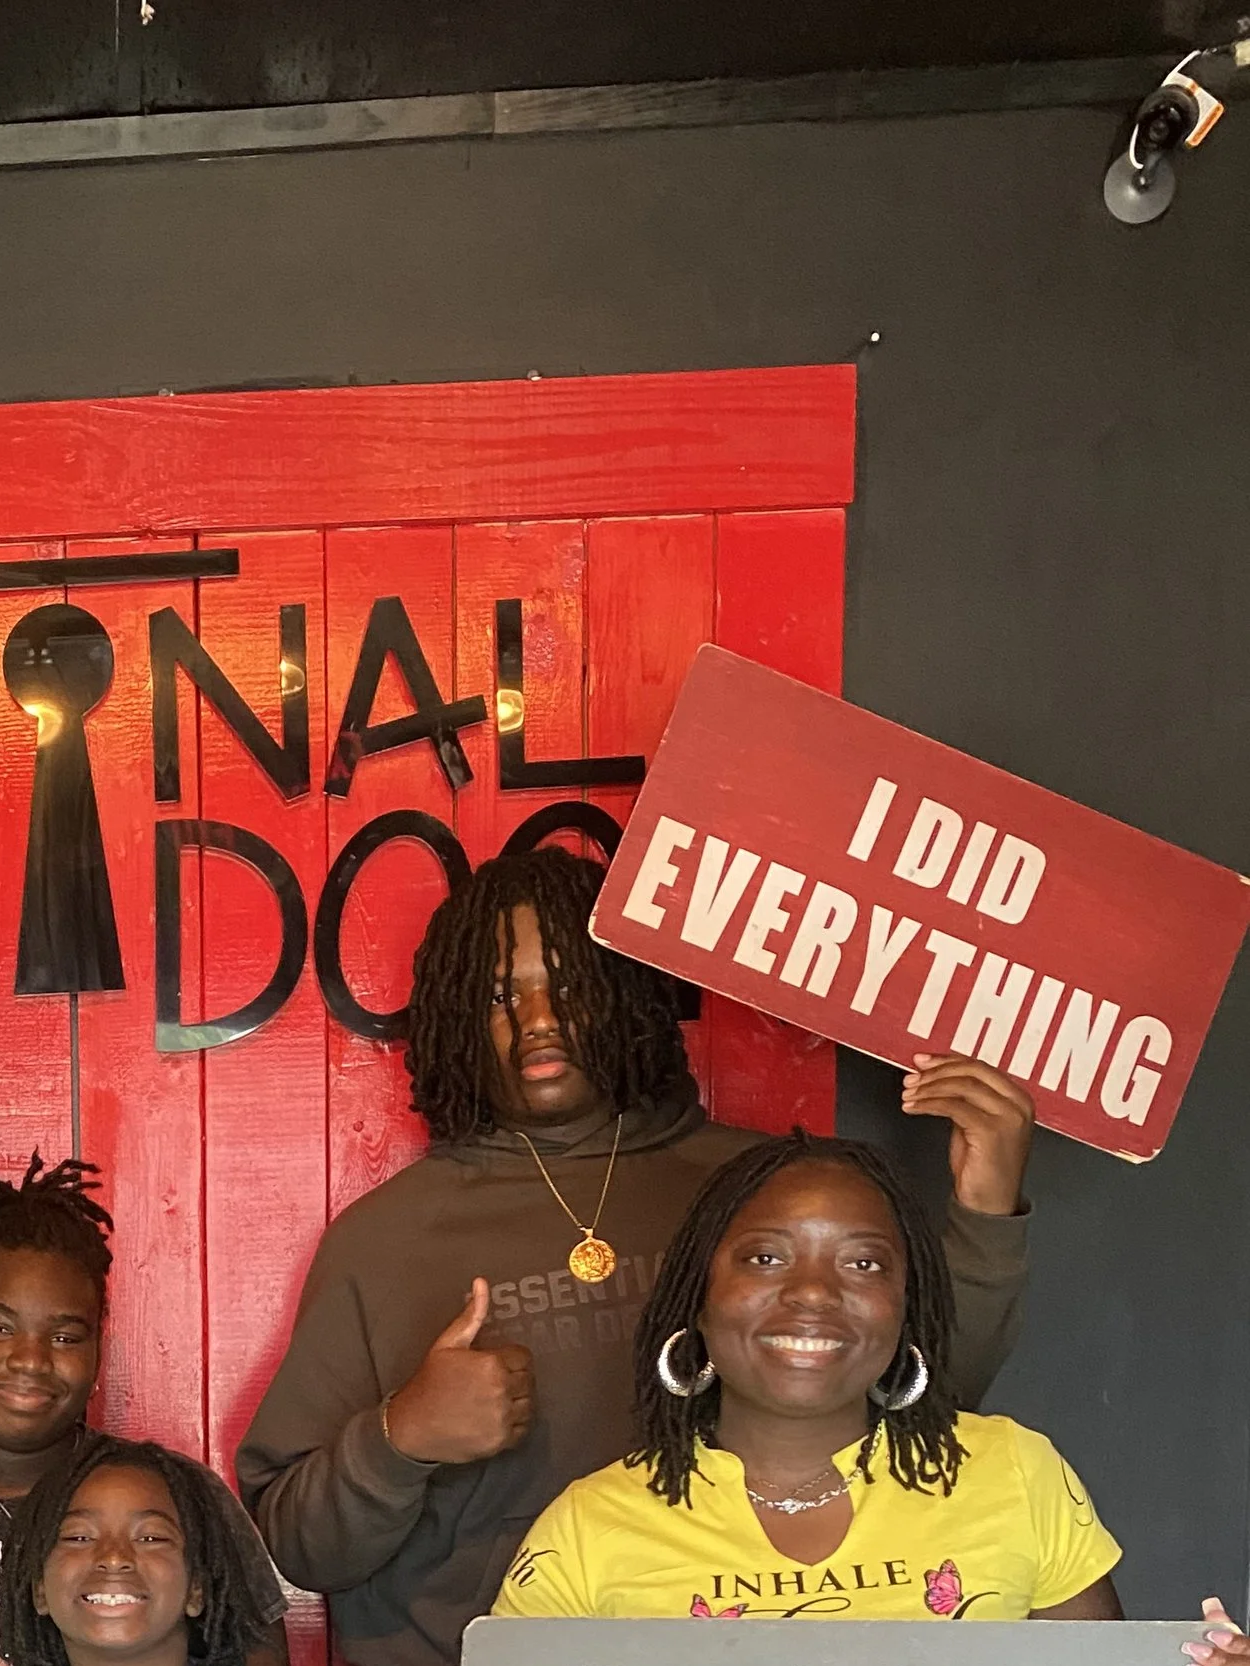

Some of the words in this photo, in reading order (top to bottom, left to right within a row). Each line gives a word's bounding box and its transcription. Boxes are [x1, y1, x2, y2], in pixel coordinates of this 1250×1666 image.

[155, 800, 701, 1052] DO
[847, 777, 898, 862] I
[892, 797, 1048, 925] DID
[622, 815, 1173, 1127] EVERYTHING
[711, 1558, 912, 1600] INHALE
